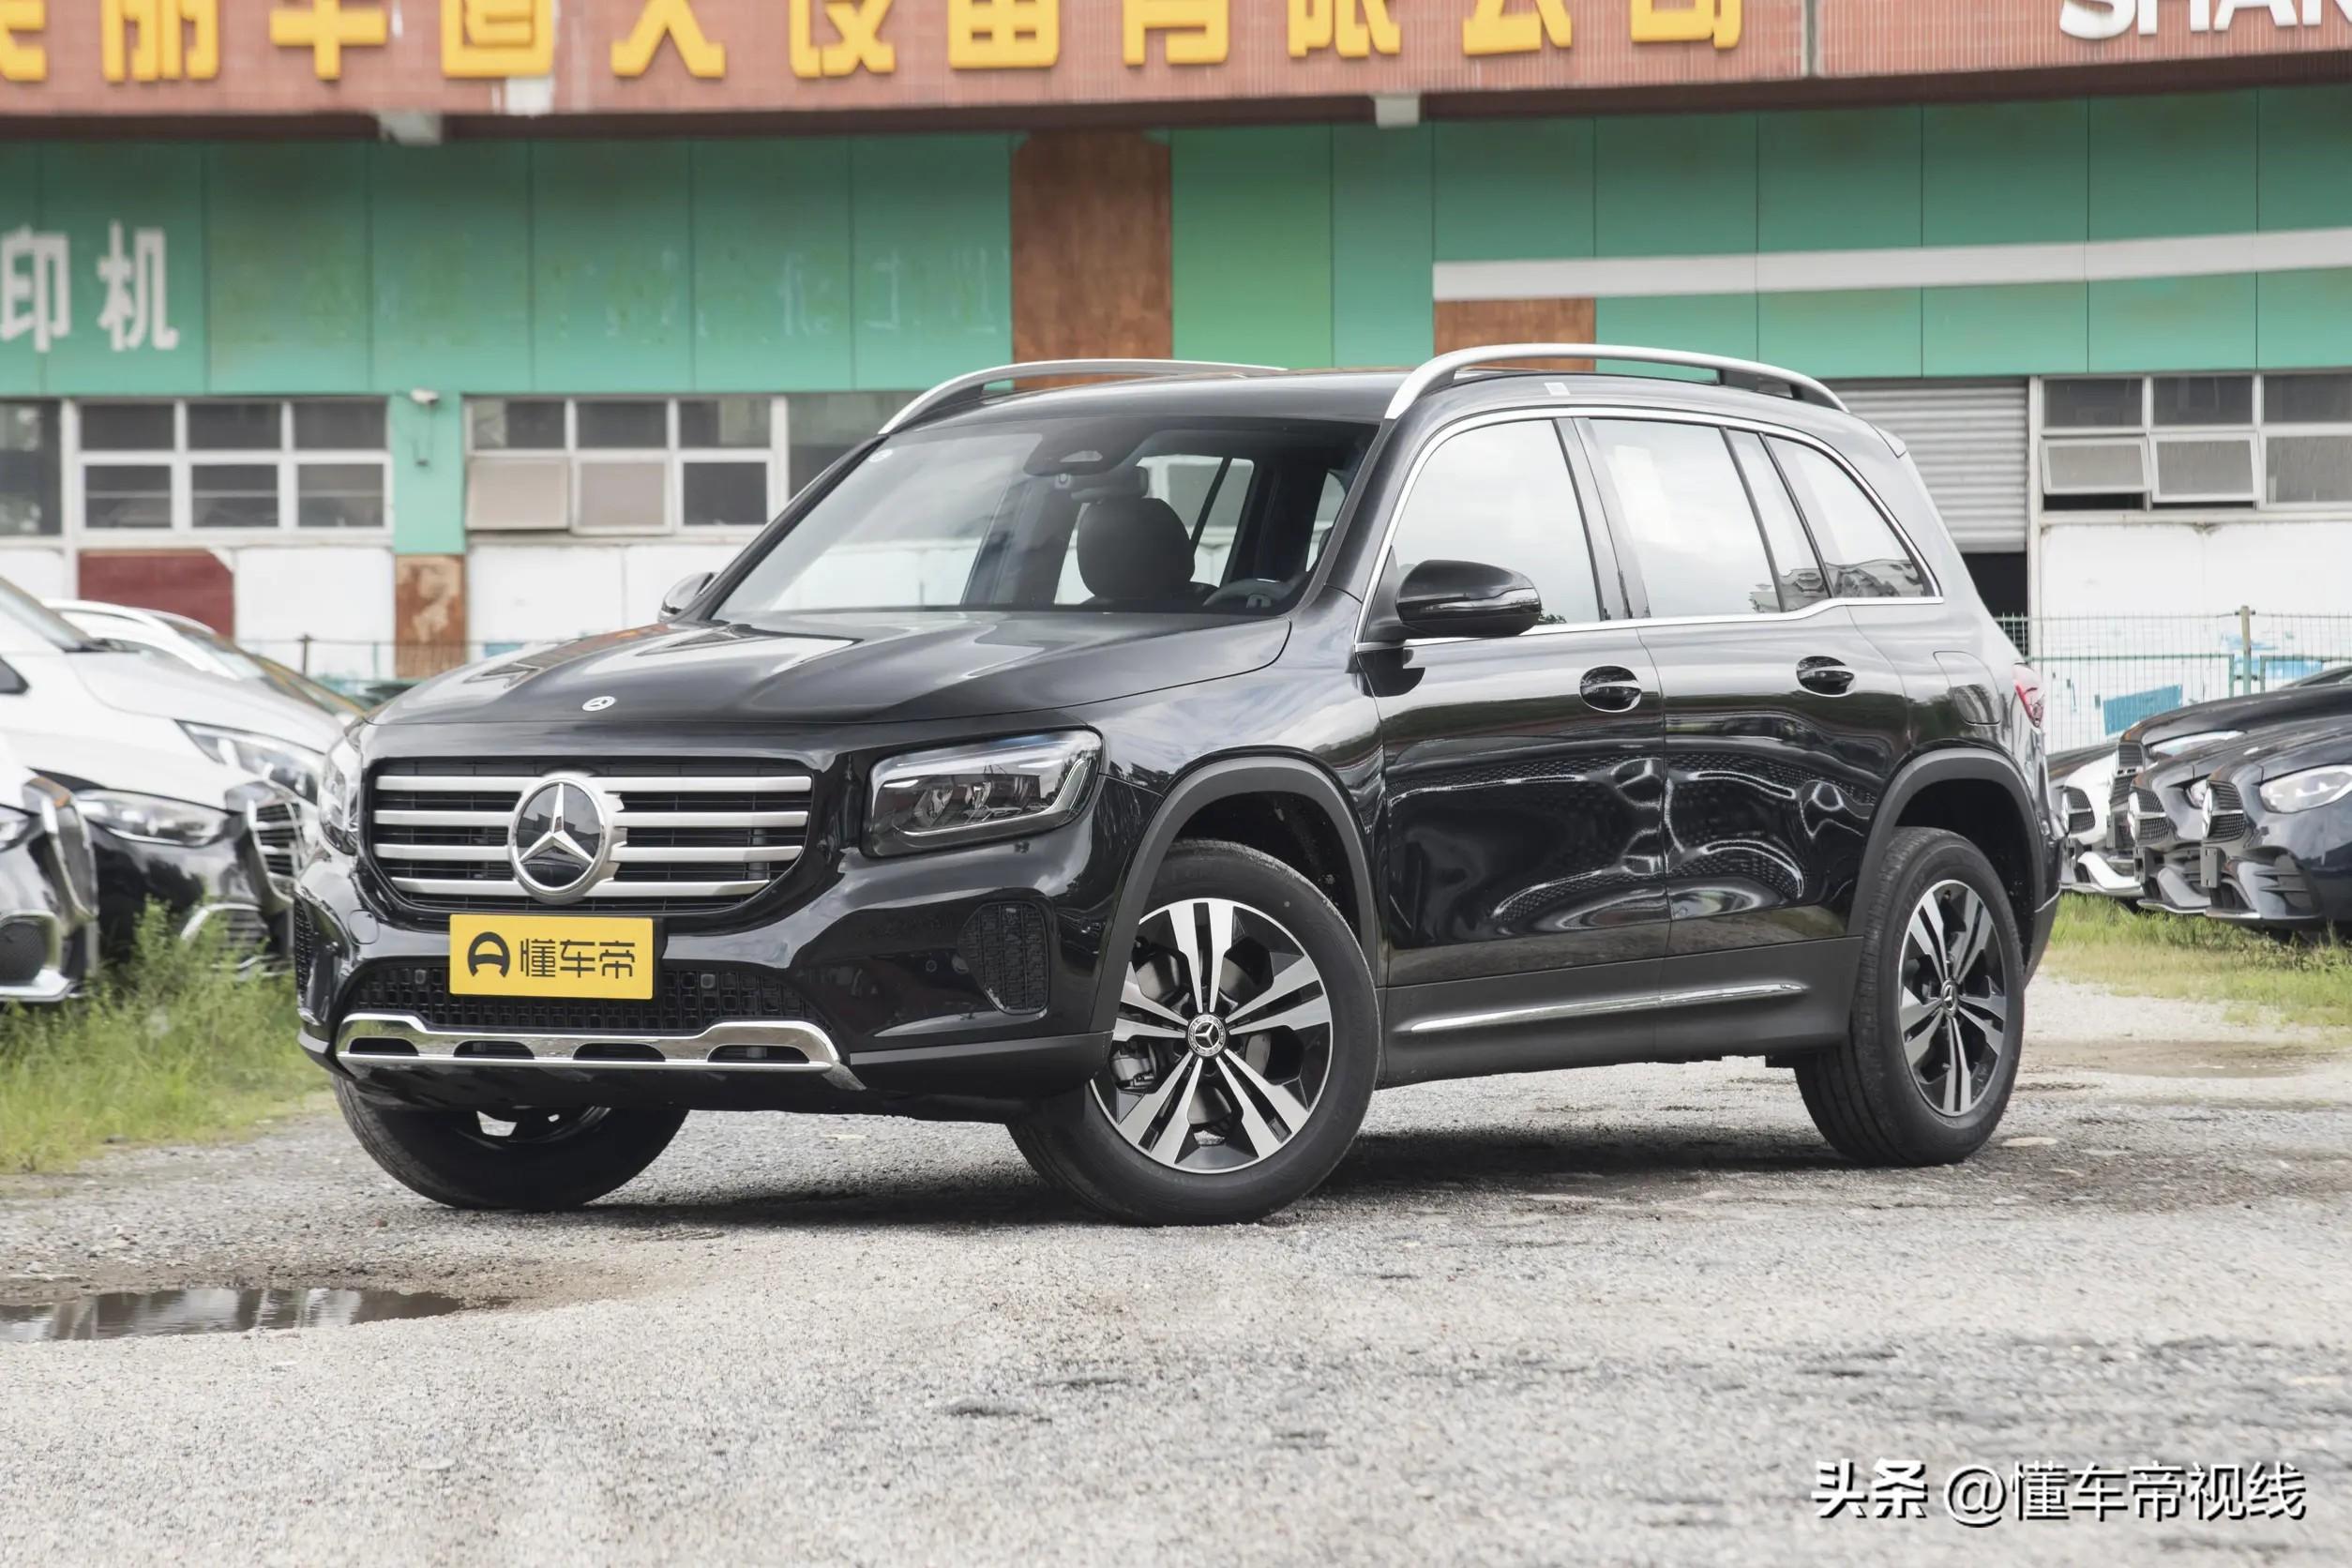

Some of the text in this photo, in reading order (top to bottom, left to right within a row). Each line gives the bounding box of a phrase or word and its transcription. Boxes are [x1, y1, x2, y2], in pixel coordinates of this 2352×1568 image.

[0, 221, 179, 353] 印机
[520, 938, 636, 979] 懂车帝
